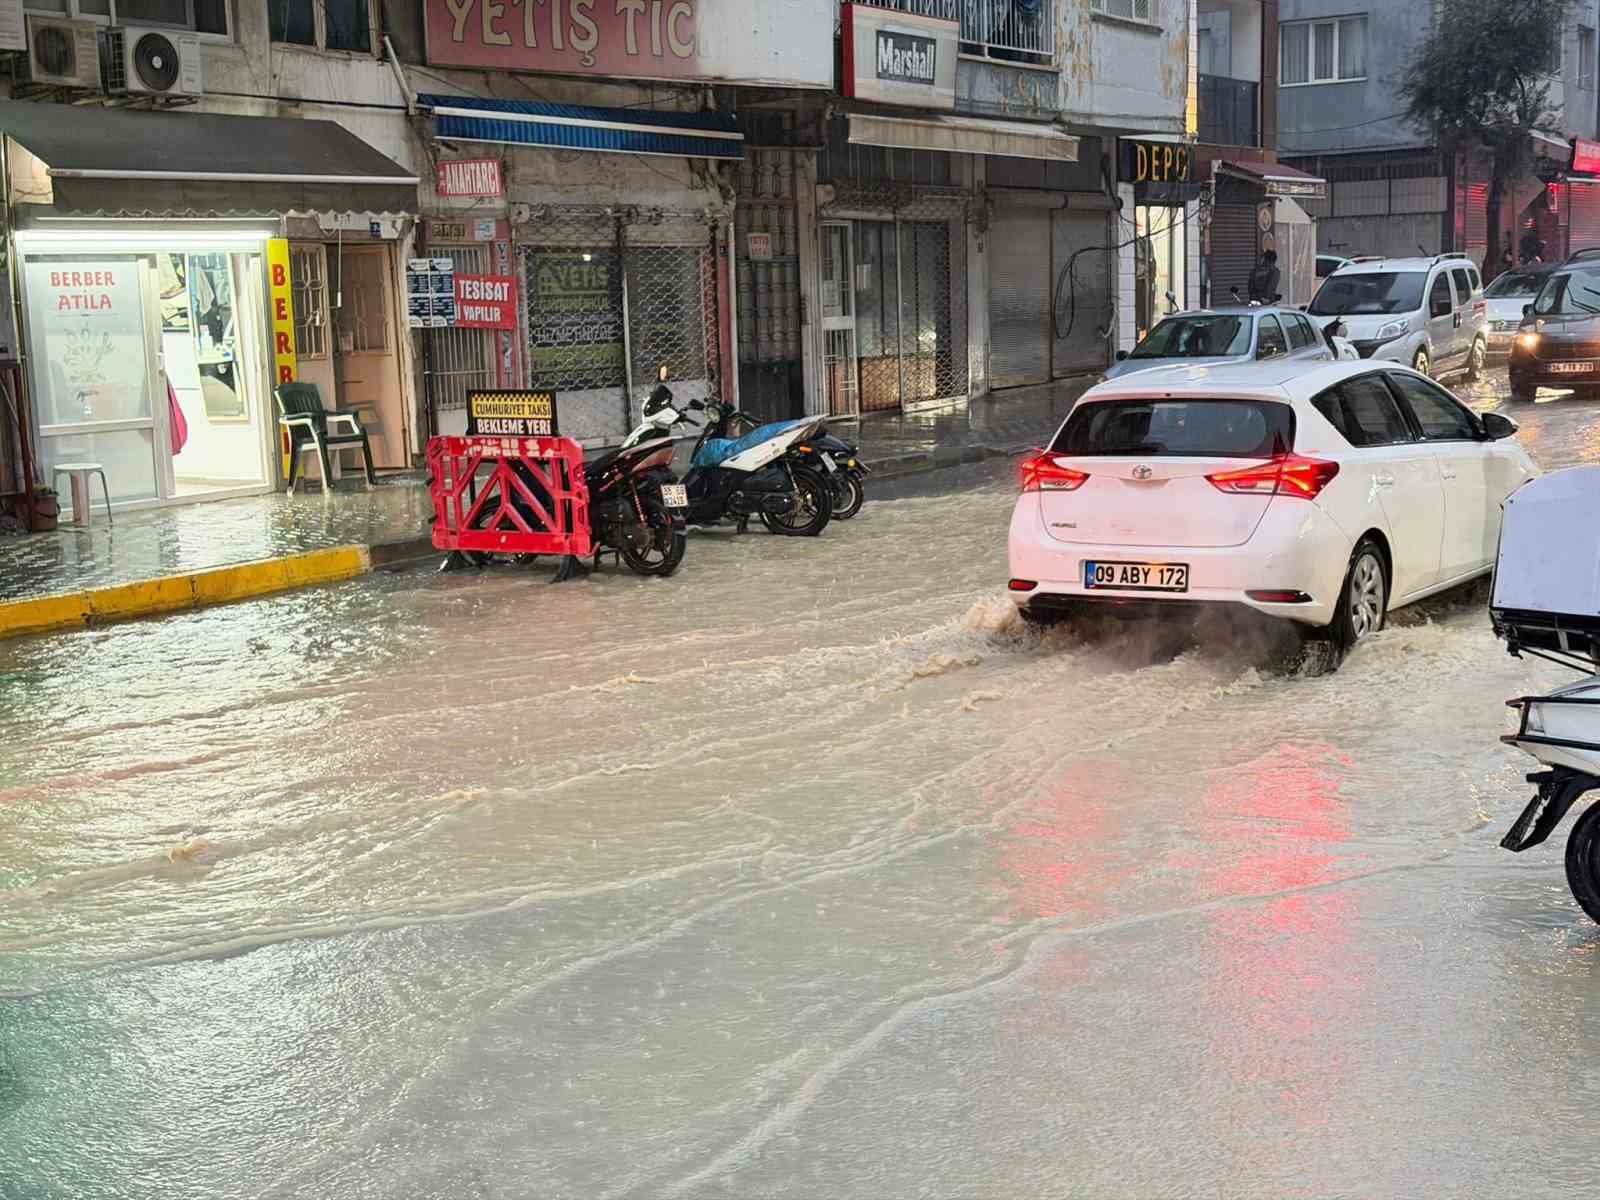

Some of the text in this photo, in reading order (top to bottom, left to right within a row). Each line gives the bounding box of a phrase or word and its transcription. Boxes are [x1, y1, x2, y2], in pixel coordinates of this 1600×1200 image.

[878, 36, 935, 79] Marshall
[445, 161, 500, 194] ANAHTARCI
[50, 271, 115, 287] BERBER
[458, 277, 510, 302] TESİSAT
[463, 304, 501, 322] YAPILIR
[477, 419, 551, 435] BEKLEME YERİ
[1095, 565, 1186, 586] 09 ABY 172
